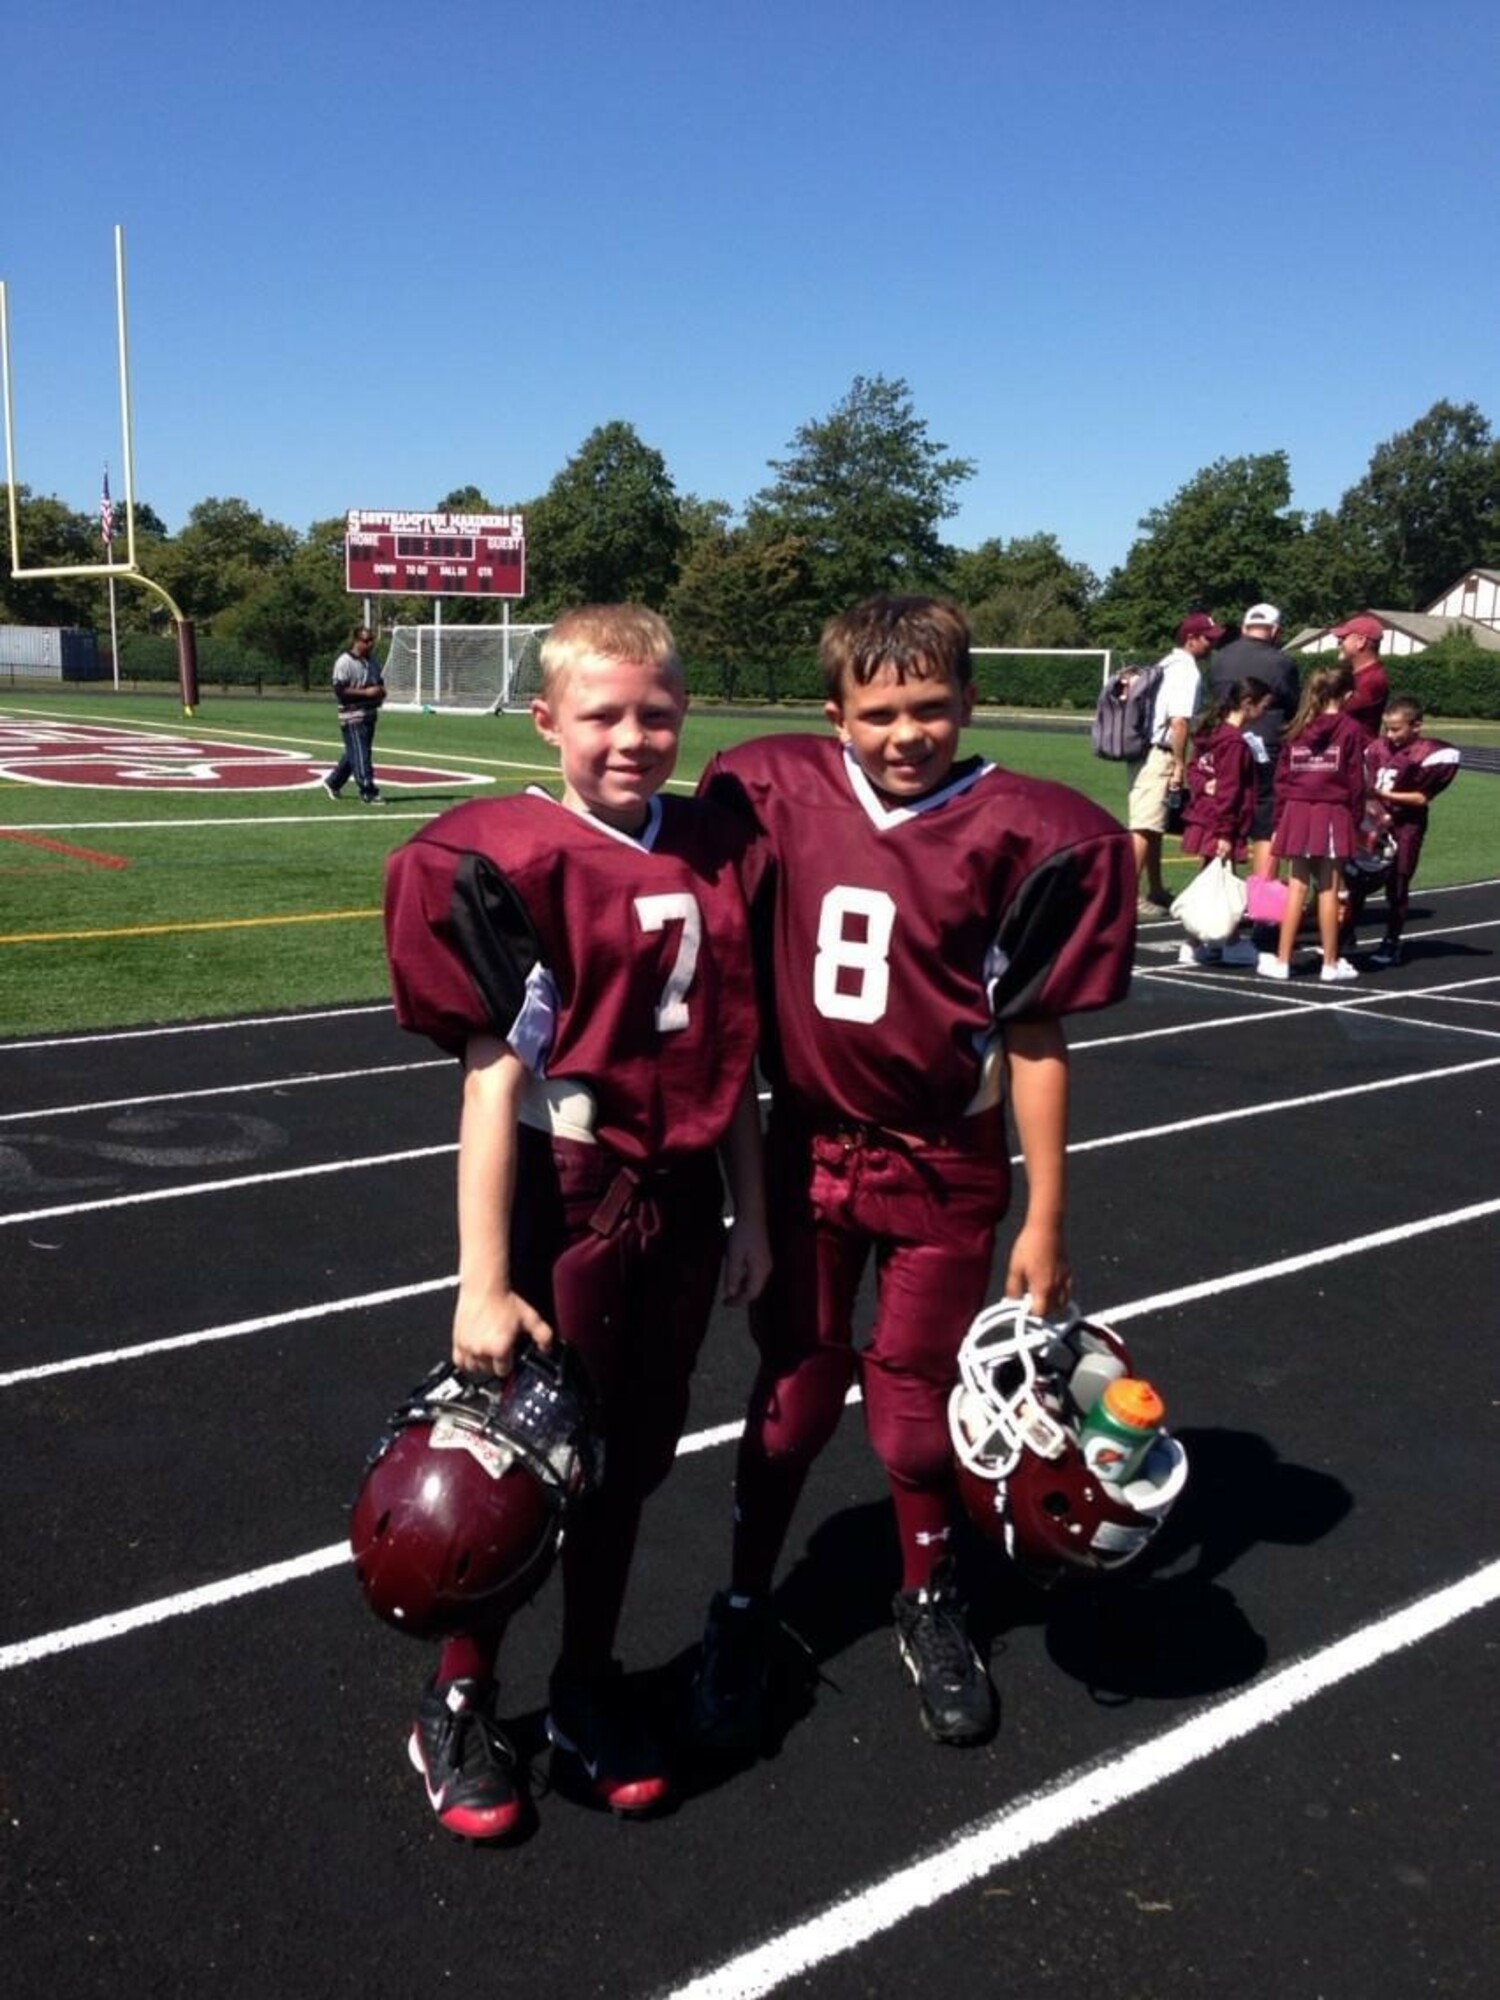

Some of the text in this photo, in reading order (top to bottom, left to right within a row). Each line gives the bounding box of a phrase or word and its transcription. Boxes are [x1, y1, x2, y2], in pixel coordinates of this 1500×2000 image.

[350, 534, 379, 546] HOME
[487, 538, 519, 550] GUEST
[373, 563, 397, 575] DOWN
[406, 564, 416, 575] TO
[440, 566, 456, 577] BALL
[813, 885, 897, 1024] 8
[634, 892, 700, 1032] 7
